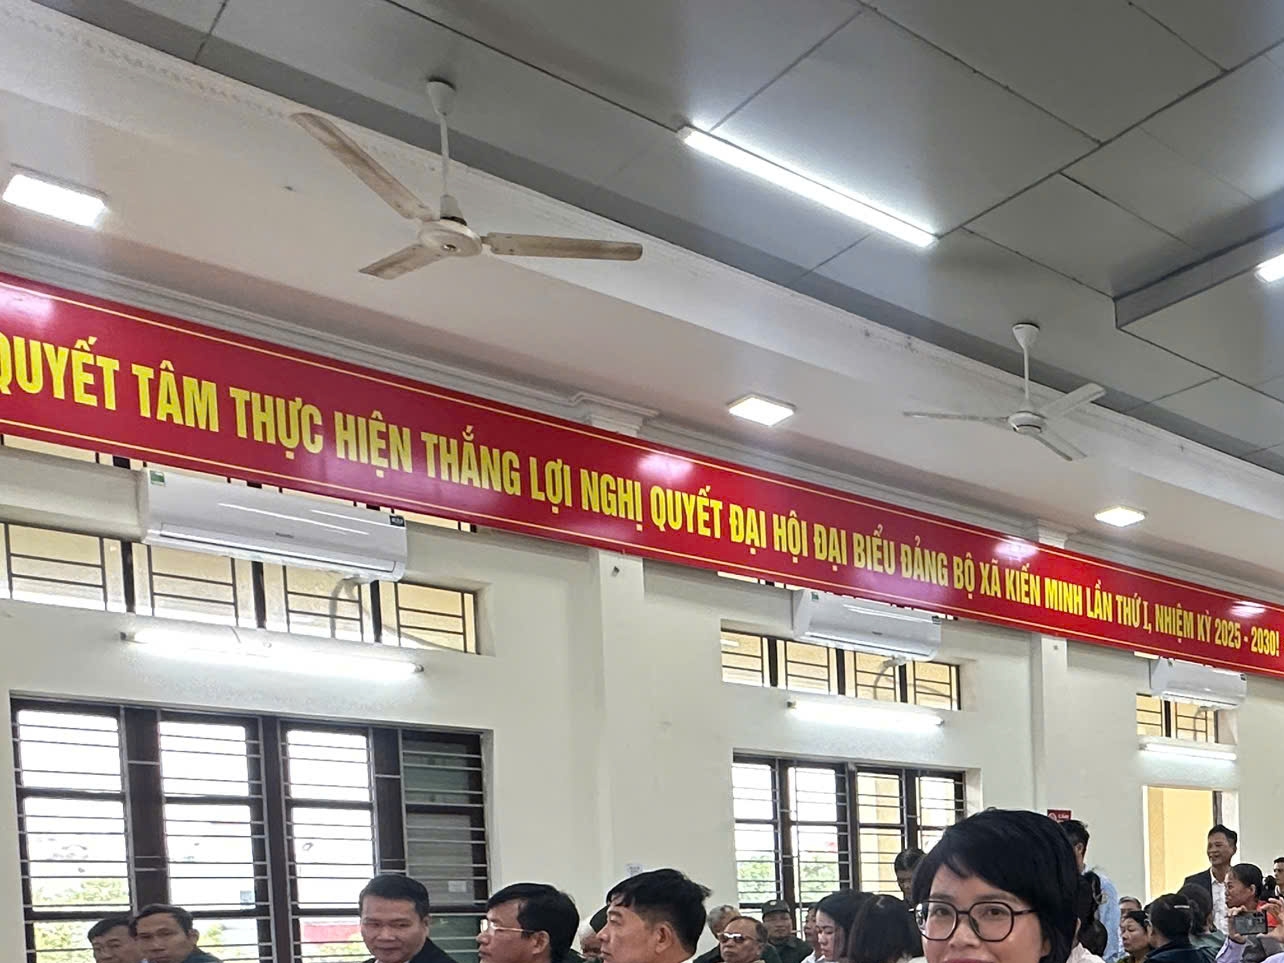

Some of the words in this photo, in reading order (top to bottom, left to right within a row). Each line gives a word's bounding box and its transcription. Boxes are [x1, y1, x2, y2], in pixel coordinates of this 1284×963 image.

[132, 360, 218, 432] TÂM
[230, 387, 322, 459] THỰC
[335, 411, 411, 477] HIỆN
[422, 426, 520, 494] THẮNG
[530, 457, 571, 515] LỢI
[581, 469, 642, 531] NGHỊ
[650, 486, 723, 538] QUYẾT
[729, 504, 766, 554] ĐẠI
[773, 512, 808, 562] HỘI
[814, 524, 847, 571] ĐẠI
[853, 524, 894, 574] BIỂU
[901, 536, 947, 586] ĐẢNG
[953, 557, 975, 599] BỘ
[980, 556, 1001, 598] XÃ
[1005, 563, 1040, 606] KIẾN
[1045, 578, 1082, 615] MINH
[1086, 584, 1112, 621] LẦN
[1116, 595, 1141, 627] THỨ
[1155, 603, 1194, 643] NHIỆM
[1197, 610, 1212, 642] KỲ
[1215, 620, 1241, 648] 2025
[1251, 626, 1279, 656] 2030!
